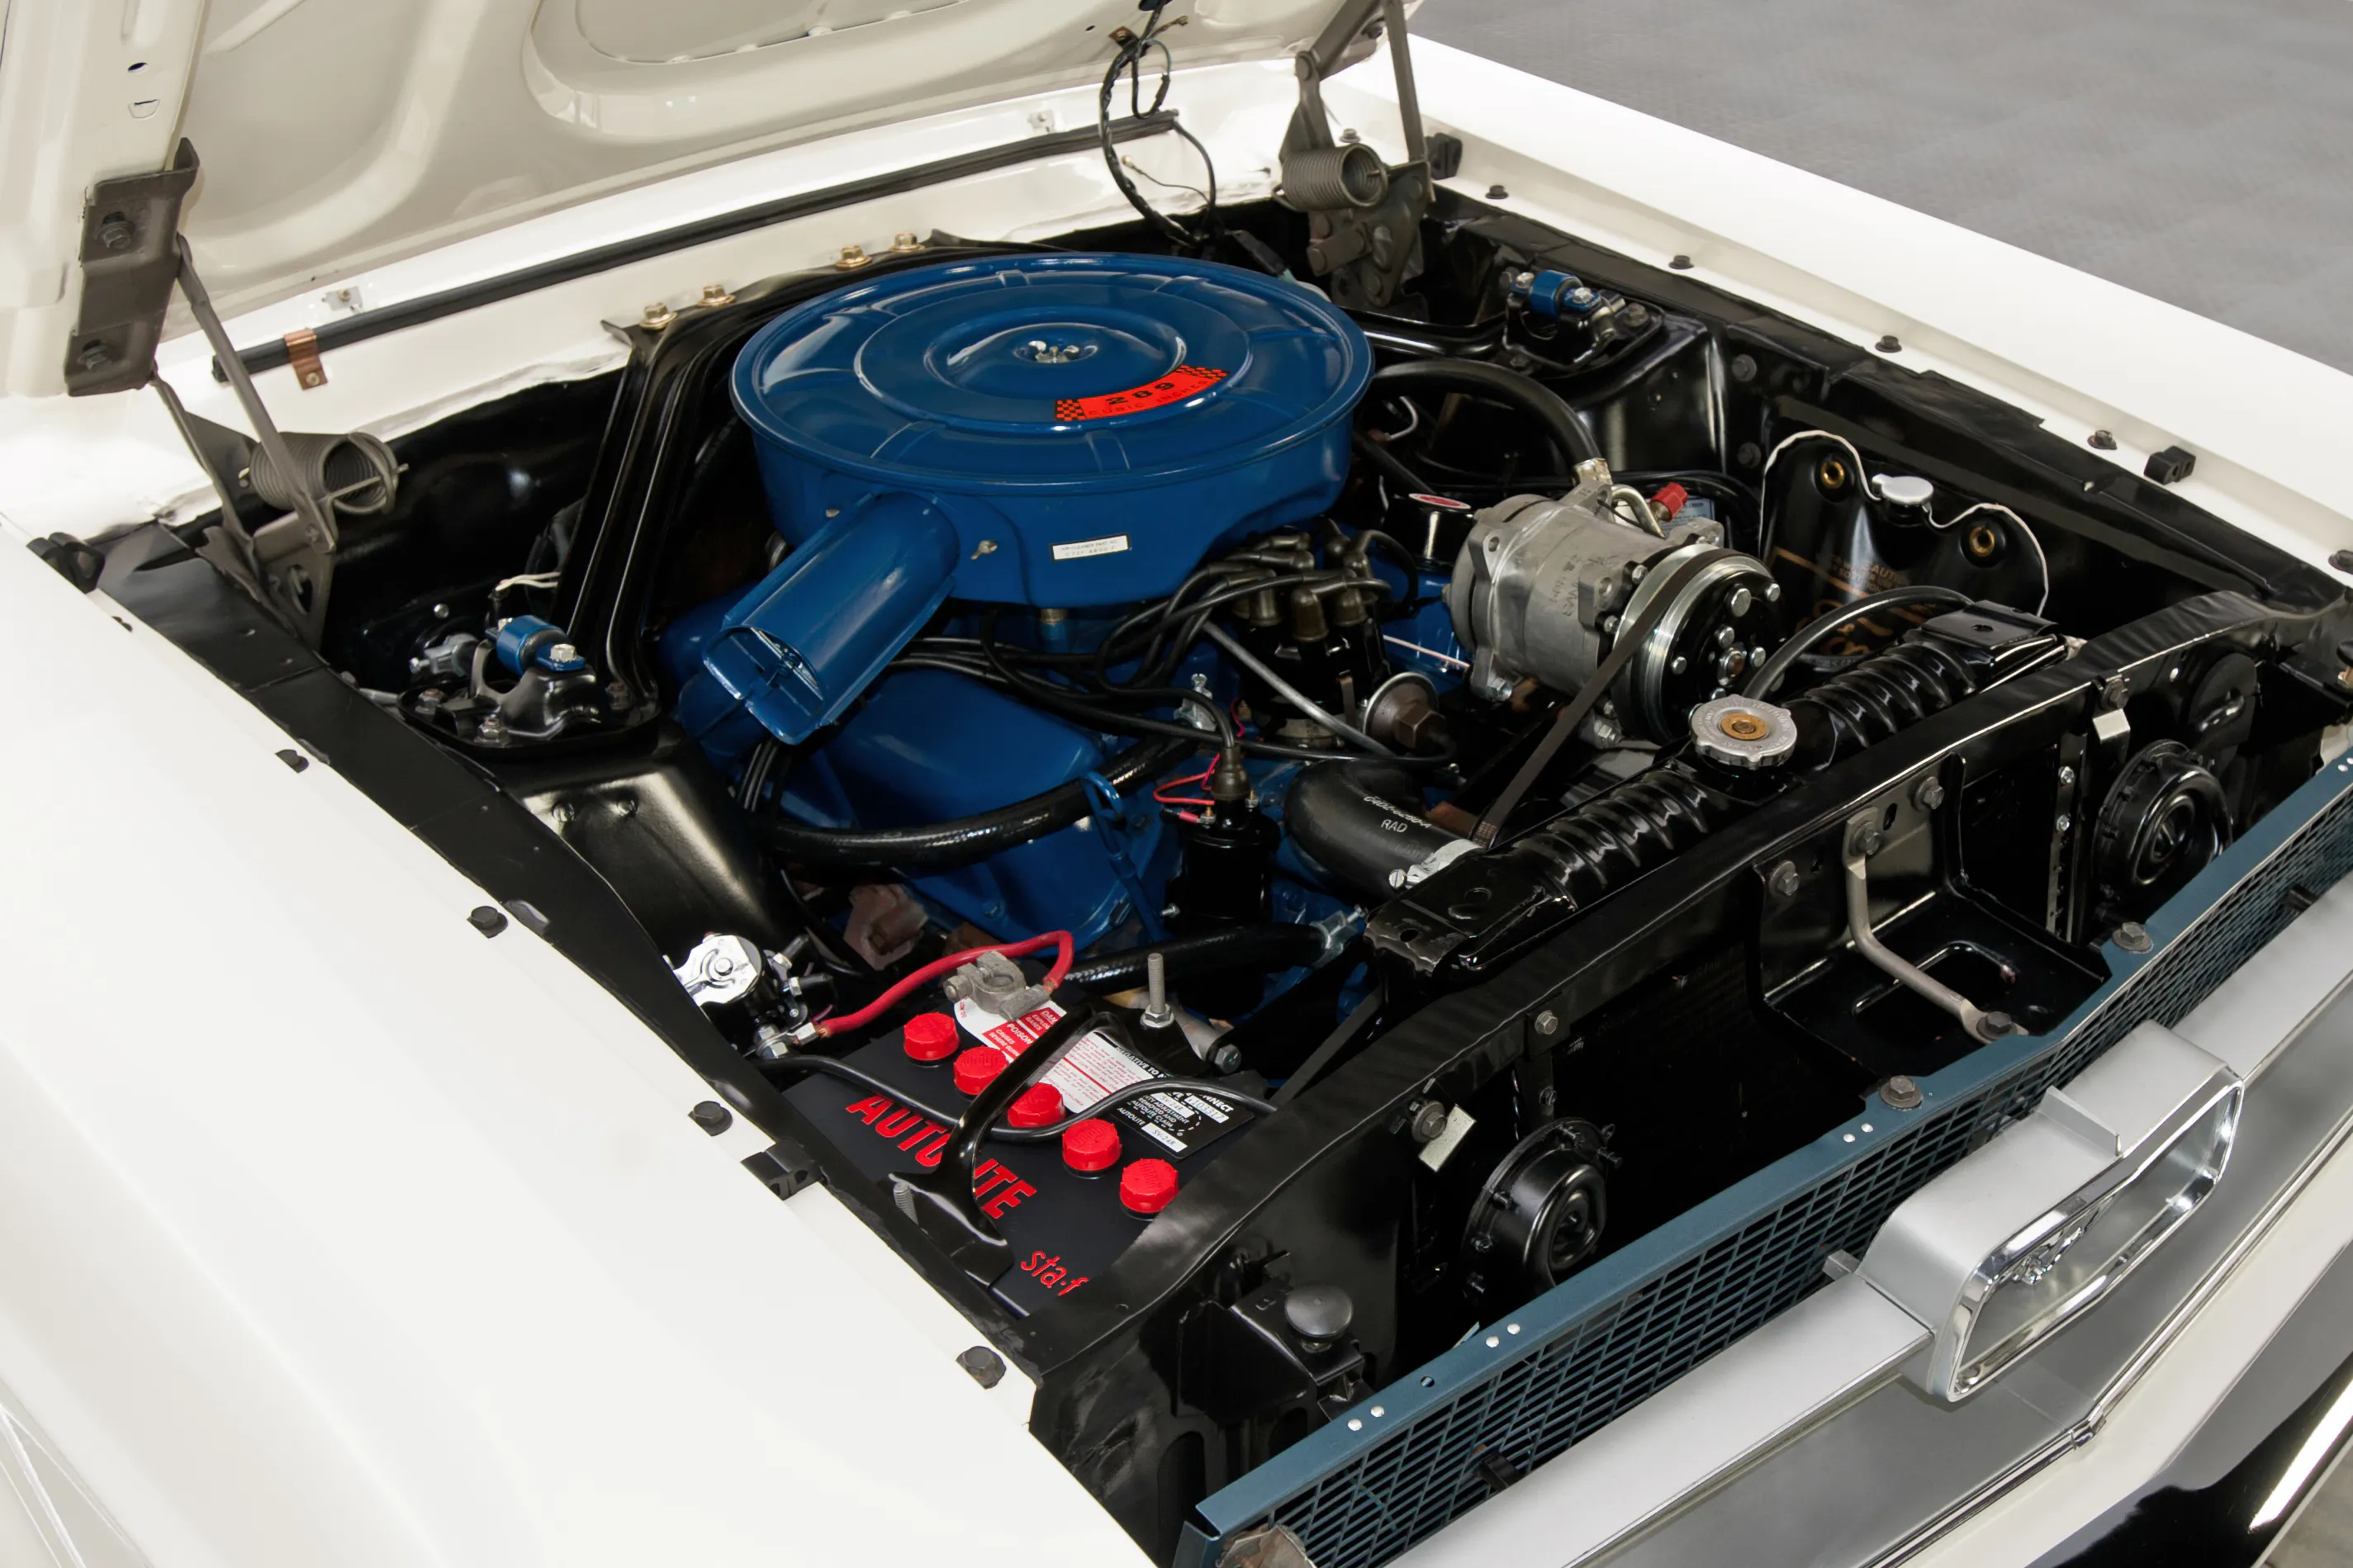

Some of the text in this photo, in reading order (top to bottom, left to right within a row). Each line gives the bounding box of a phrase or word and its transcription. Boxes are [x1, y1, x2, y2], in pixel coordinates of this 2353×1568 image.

[1089, 381, 1207, 415] CUBIC INCHES
[1106, 383, 1174, 405] 289
[1381, 819, 1407, 833] RAD
[1007, 1023, 1033, 1045] POISON
[1025, 1016, 1043, 1030] GASES
[996, 1029, 1015, 1045] CAUSES
[1148, 1067, 1160, 1076] TO
[1117, 1107, 1146, 1125] AUTOLITE
[1131, 1100, 1174, 1128] AUTOLITE CLAIM
[1138, 1097, 1165, 1115] REMOVED
[1162, 1113, 1177, 1123] AND
[1154, 1101, 1190, 1124] ADJUSTMENT
[846, 1091, 1037, 1220] AUTOITE
